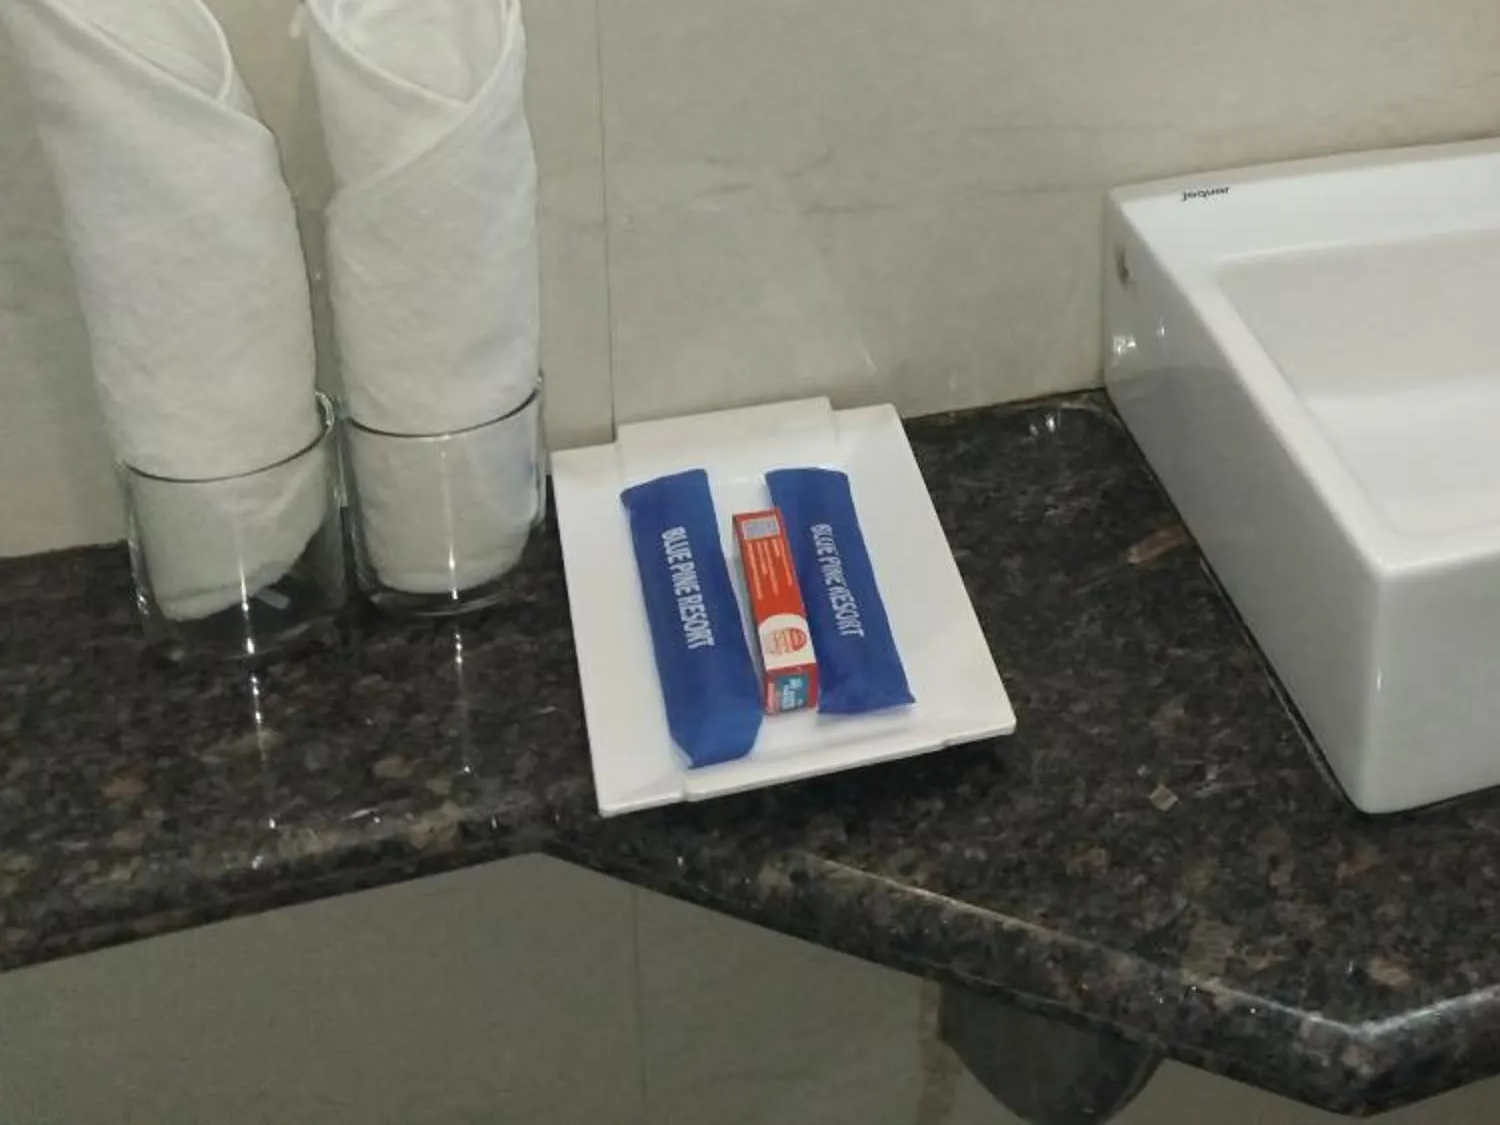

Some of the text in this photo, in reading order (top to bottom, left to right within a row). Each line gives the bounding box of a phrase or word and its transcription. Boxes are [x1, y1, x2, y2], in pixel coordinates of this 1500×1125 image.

[661, 526, 715, 649] BLUE PINE RESORT
[811, 524, 865, 637] BLUE PINE RESORT
